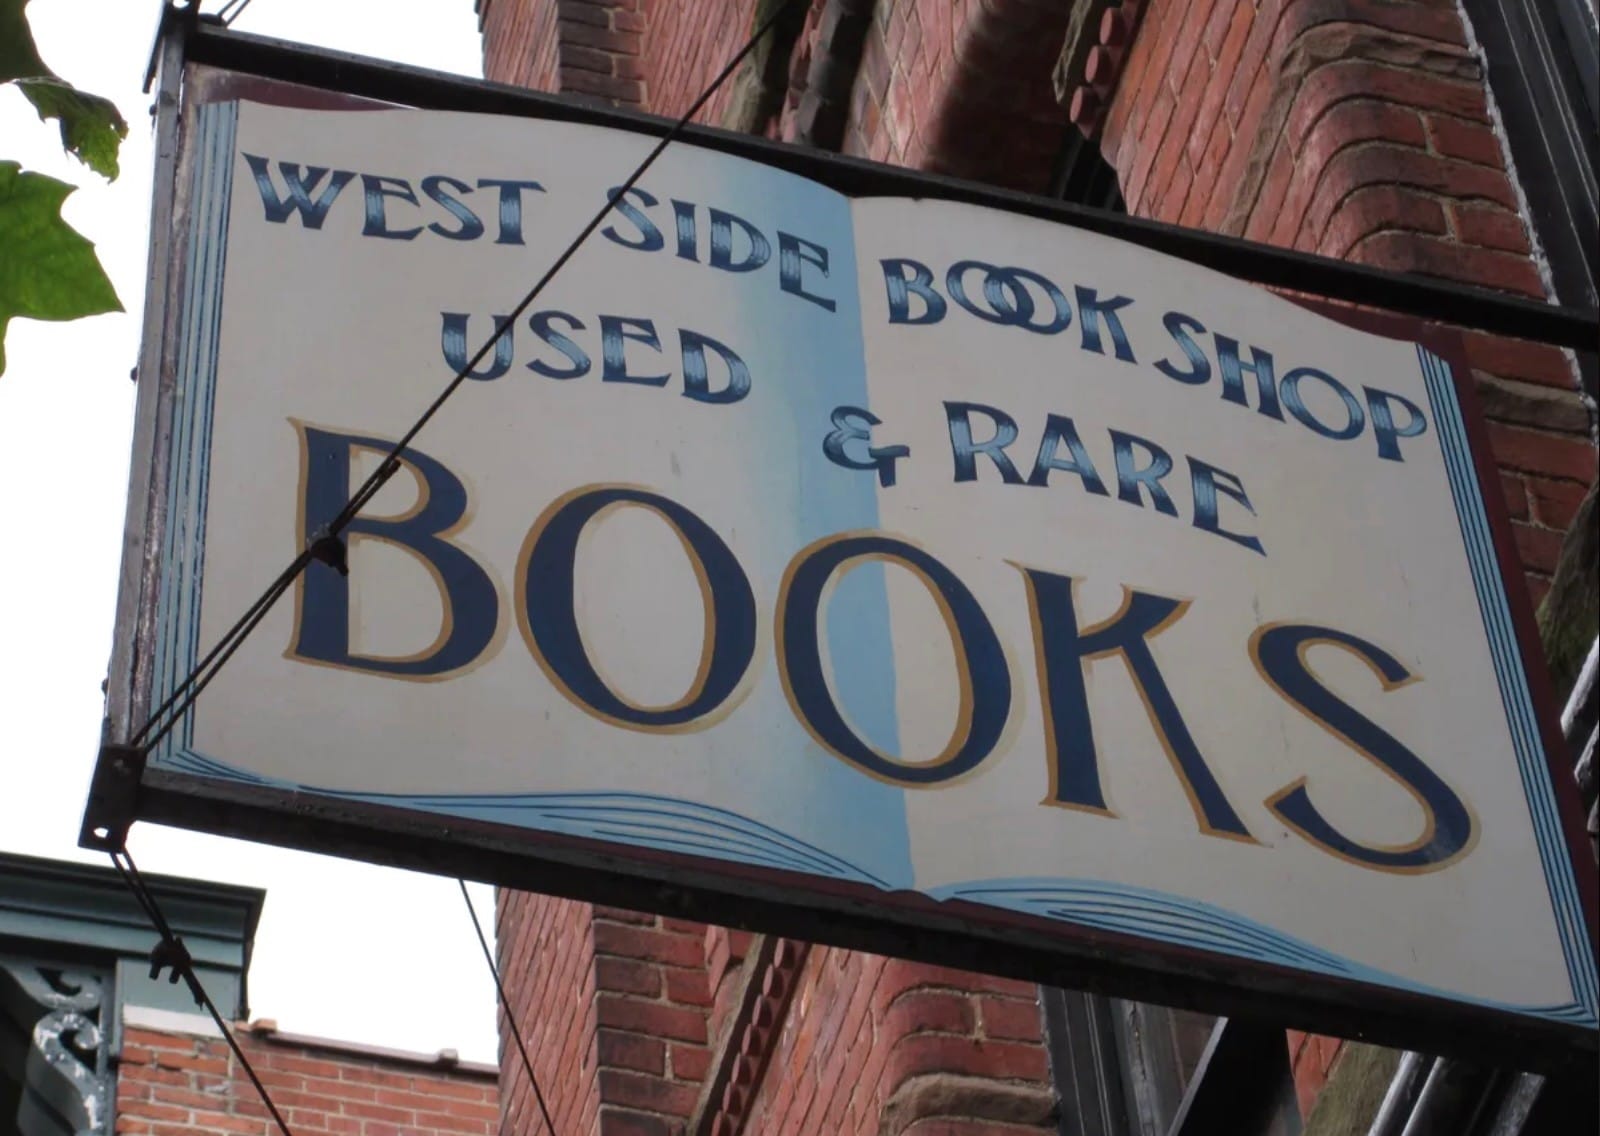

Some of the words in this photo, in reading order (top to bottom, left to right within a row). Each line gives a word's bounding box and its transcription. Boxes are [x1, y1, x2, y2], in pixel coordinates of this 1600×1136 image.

[242, 152, 547, 246] WEST
[601, 186, 836, 312] SIDE
[879, 258, 1138, 364] BOOK
[1153, 311, 1428, 462] SHOP
[441, 310, 752, 404] USED
[822, 405, 910, 488] &
[943, 400, 1267, 557] RARE
[283, 417, 1481, 876] BOOKS
